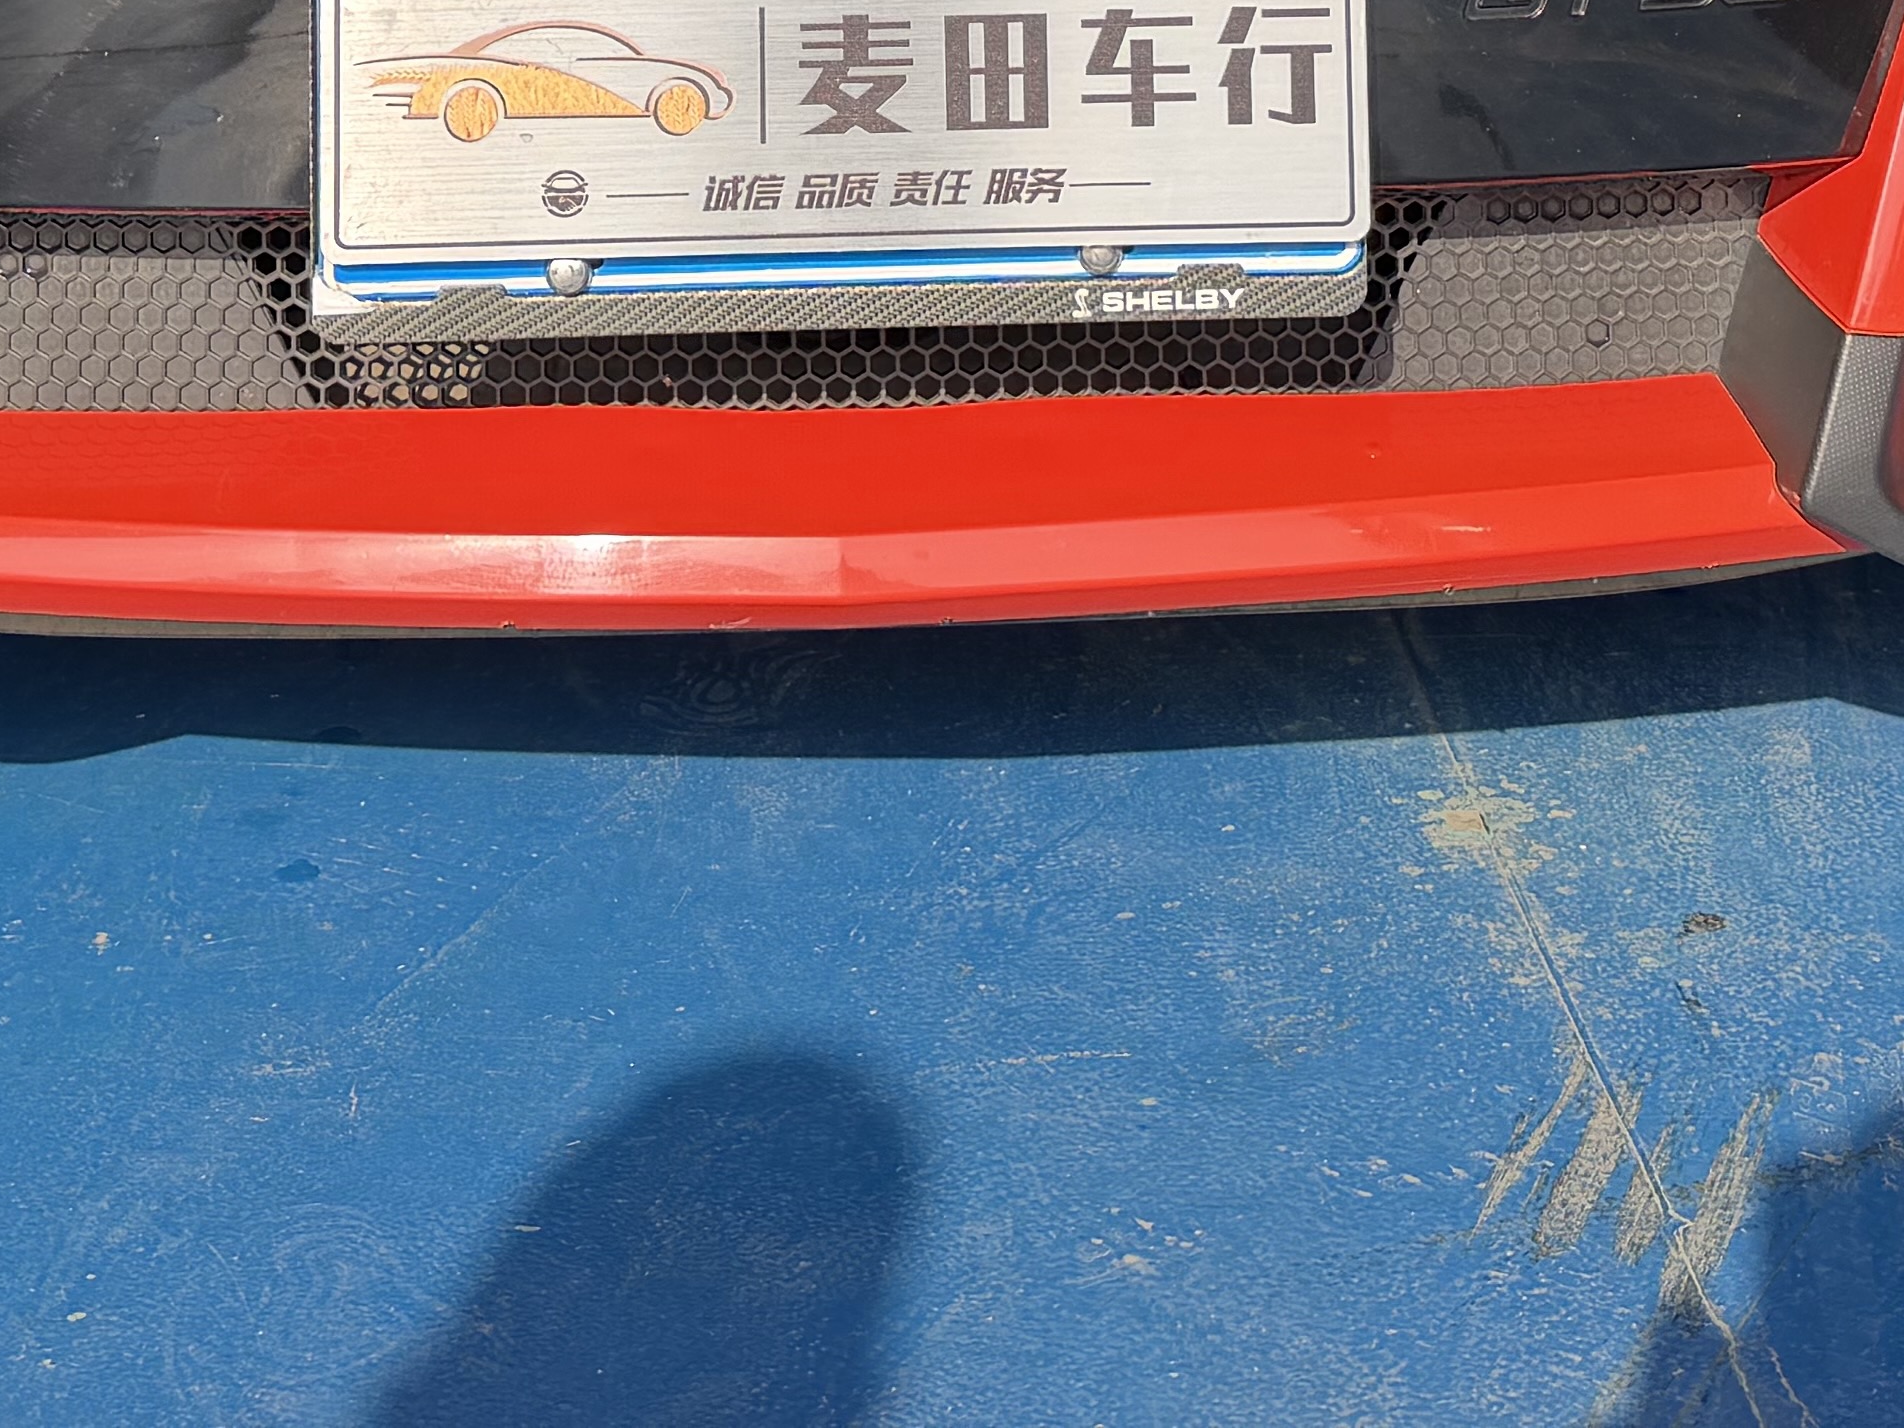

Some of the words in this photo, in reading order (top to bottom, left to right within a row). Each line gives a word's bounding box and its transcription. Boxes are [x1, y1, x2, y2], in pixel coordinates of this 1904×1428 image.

[797, 5, 1333, 136] 麦田车行
[702, 173, 785, 212] 诚信
[794, 171, 878, 209] 品质
[890, 169, 973, 207] 责任
[983, 167, 1069, 205] 服务
[1102, 287, 1245, 314] SHELBY
